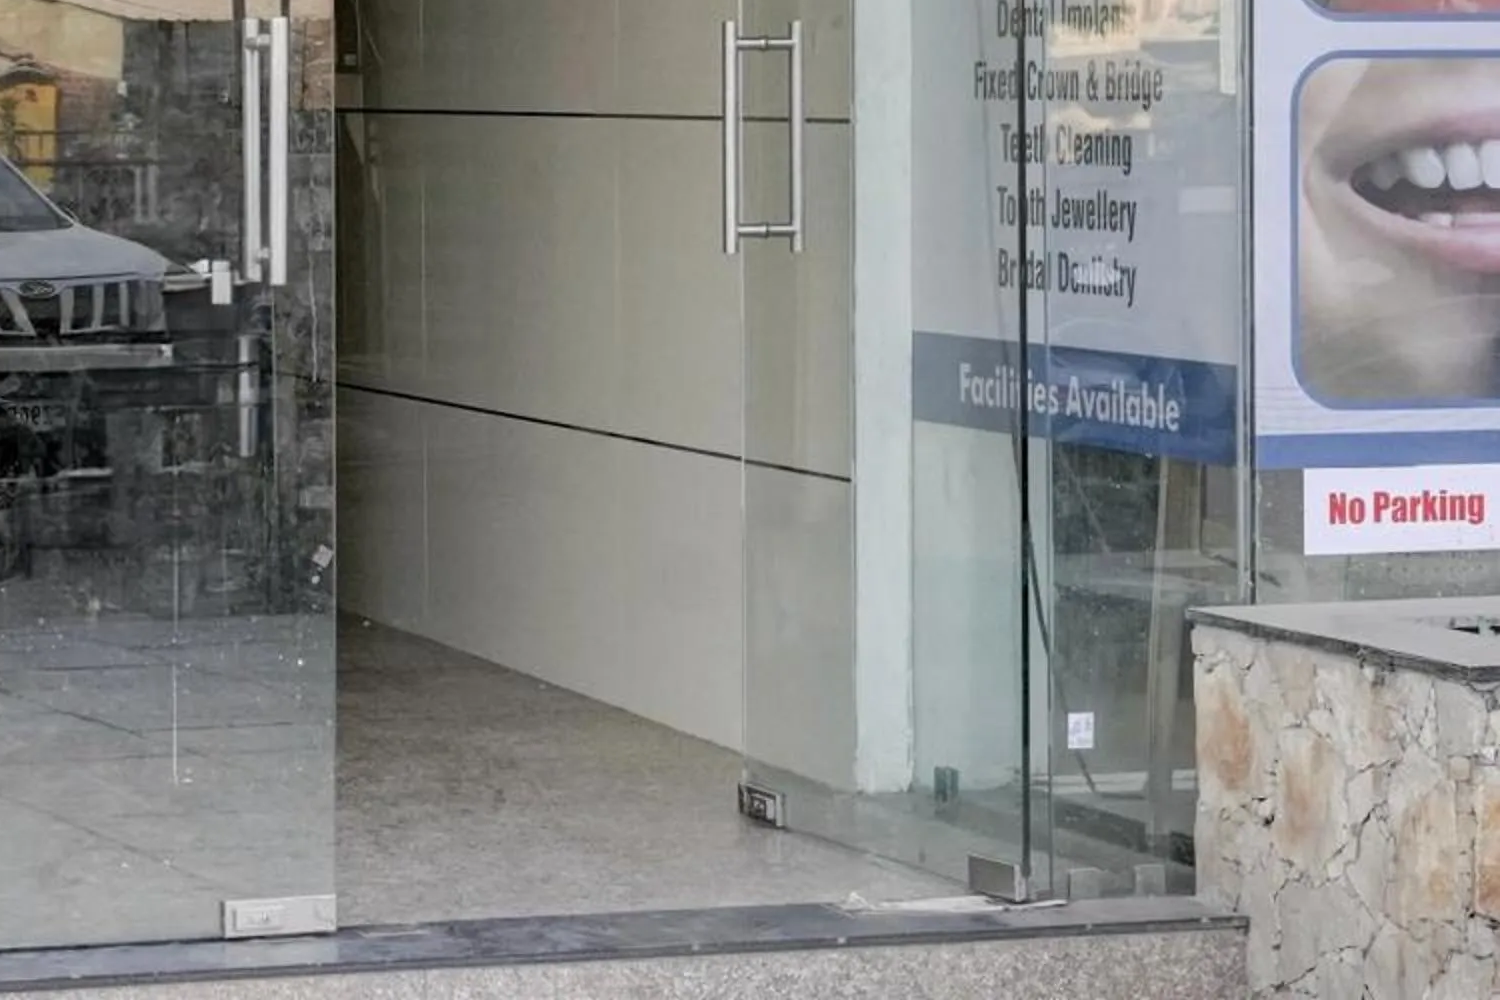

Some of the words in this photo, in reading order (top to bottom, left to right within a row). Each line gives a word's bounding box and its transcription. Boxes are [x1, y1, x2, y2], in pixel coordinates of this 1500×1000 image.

[974, 60, 1018, 101] Fixed
[1027, 60, 1080, 102] Crown
[1086, 60, 1099, 100] &
[1105, 59, 1164, 110] Bridge
[1055, 124, 1133, 177] Cleaning
[996, 185, 1046, 227] Toth
[1051, 188, 1137, 243] Jewellery
[997, 248, 1052, 291] Brdal
[958, 362, 1059, 416] Faciliies
[1065, 375, 1181, 433] Available
[1328, 491, 1366, 525] No
[1372, 489, 1486, 525] Parking
